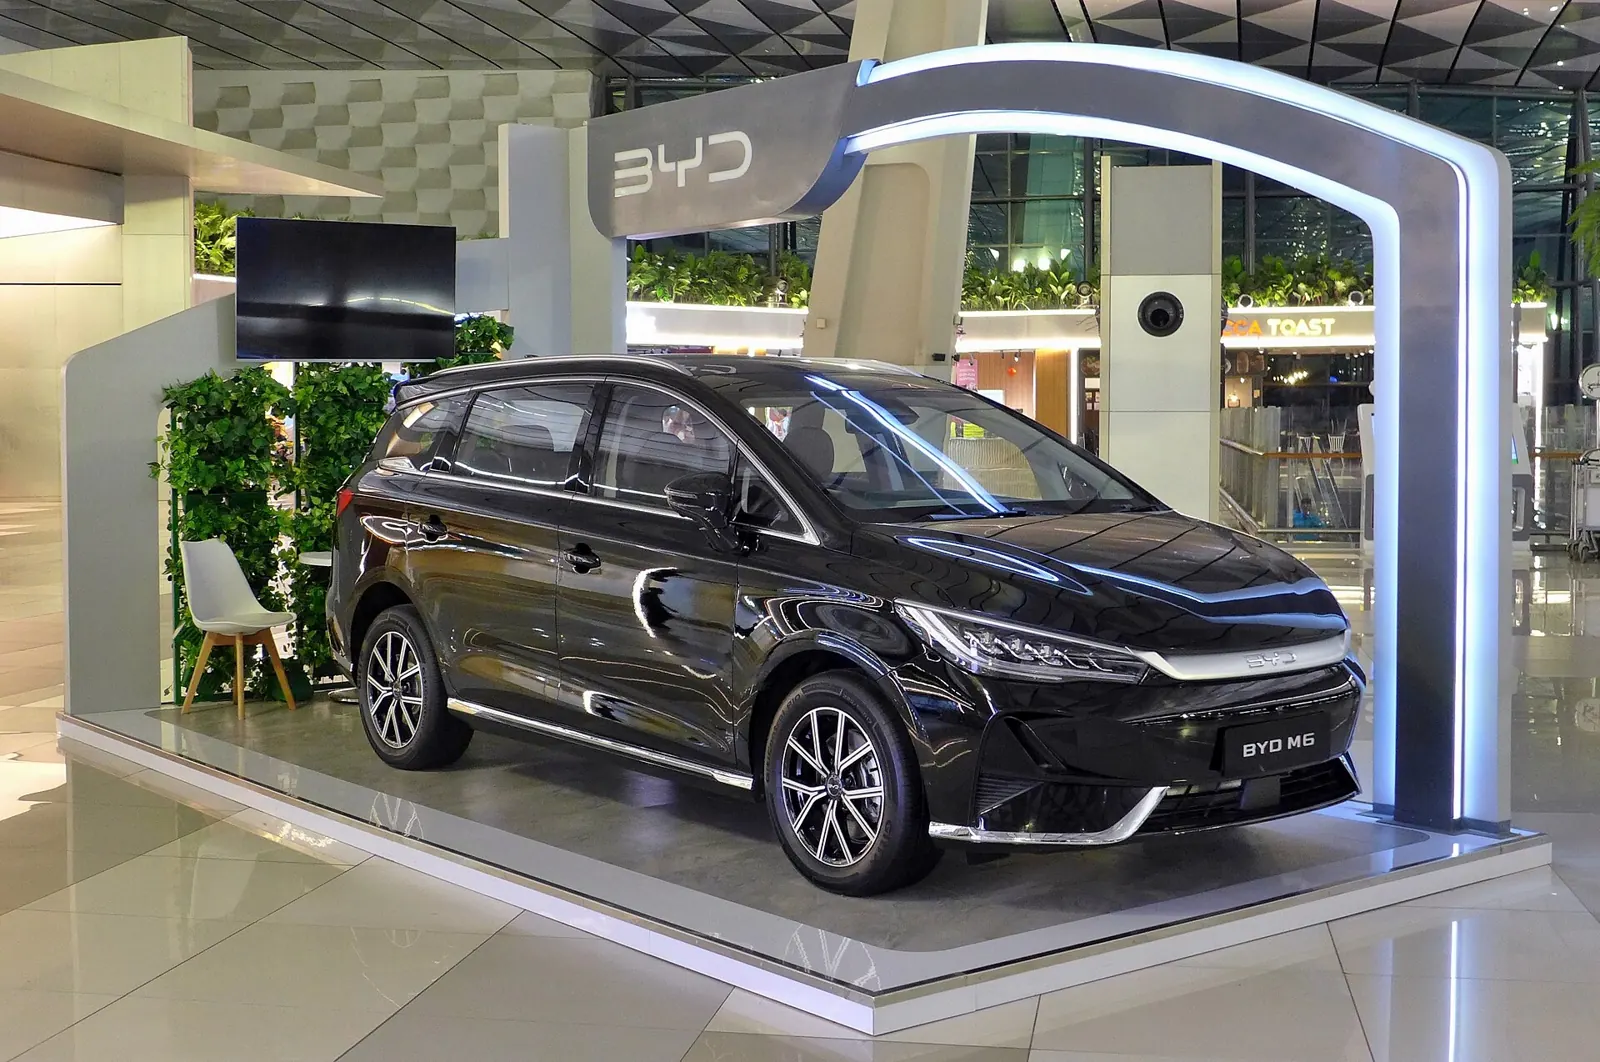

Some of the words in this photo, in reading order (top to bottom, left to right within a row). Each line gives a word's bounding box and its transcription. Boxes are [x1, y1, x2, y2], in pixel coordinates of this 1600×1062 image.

[614, 130, 753, 198] BYD
[1267, 317, 1336, 337] TOAST
[1244, 650, 1298, 669] BYD
[1242, 738, 1283, 758] BYD
[1287, 732, 1316, 750] M6
